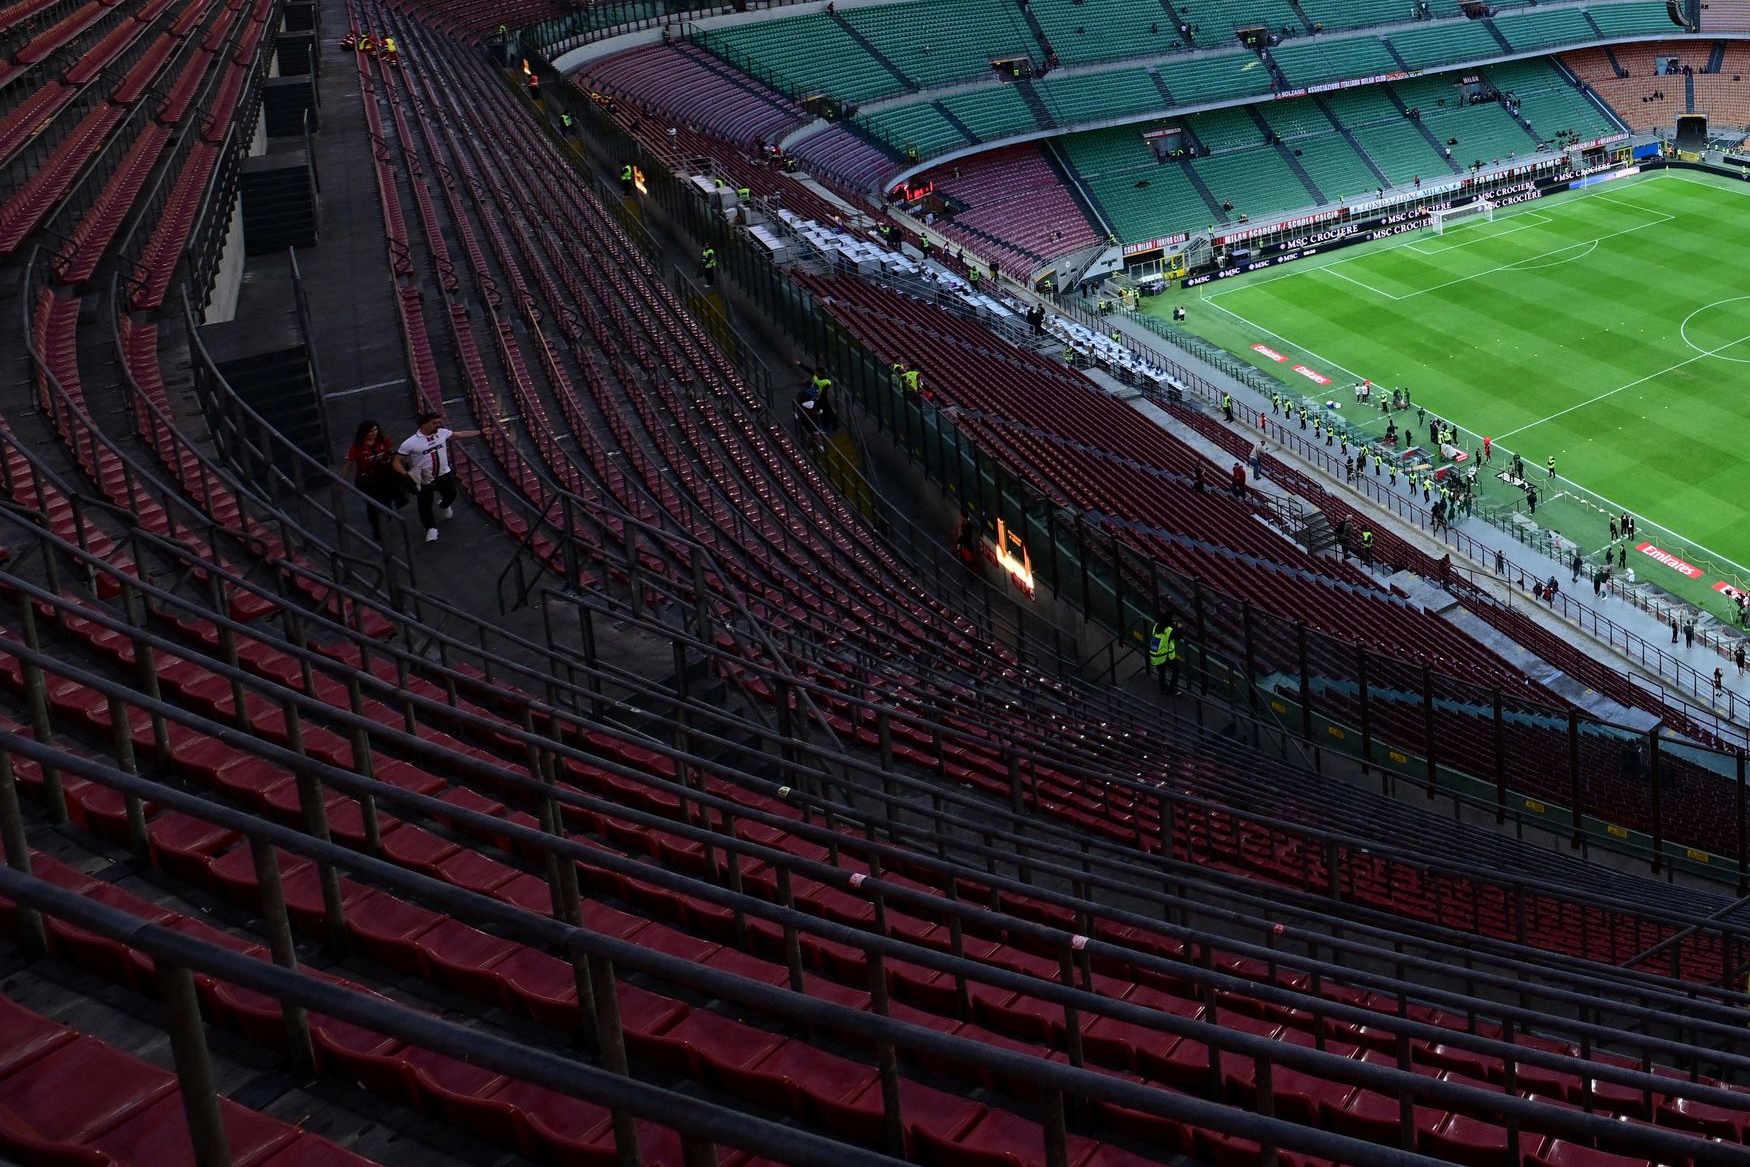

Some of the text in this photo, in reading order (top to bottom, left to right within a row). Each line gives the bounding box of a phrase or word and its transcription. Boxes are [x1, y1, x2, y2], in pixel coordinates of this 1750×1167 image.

[1281, 88, 1305, 98] BOLZANO
[1474, 170, 1510, 185] FAMILY
[1514, 165, 1534, 175] DAY
[1559, 172, 1574, 182] MSC
[1362, 186, 1449, 212] FONDAZIONE MILAN
[1478, 189, 1494, 201] MSC
[1484, 190, 1542, 211] MSC CROCIERE
[1388, 202, 1452, 224] MSC CRCIERE
[1224, 232, 1248, 244] MILAN
[1249, 224, 1281, 238] ACADEMY
[1288, 216, 1314, 229] SCUOLA
[1315, 210, 1339, 224] CALCIO
[1288, 224, 1359, 250] MSC CROCIERE
[1373, 216, 1440, 240] MSC CROCIERE
[1124, 244, 1137, 254] CASA
[1194, 274, 1210, 284] MSC
[1225, 267, 1240, 277] MSC
[1254, 260, 1270, 269] MSC
[1284, 252, 1298, 262] MSC
[1642, 545, 1694, 575] Emirates
